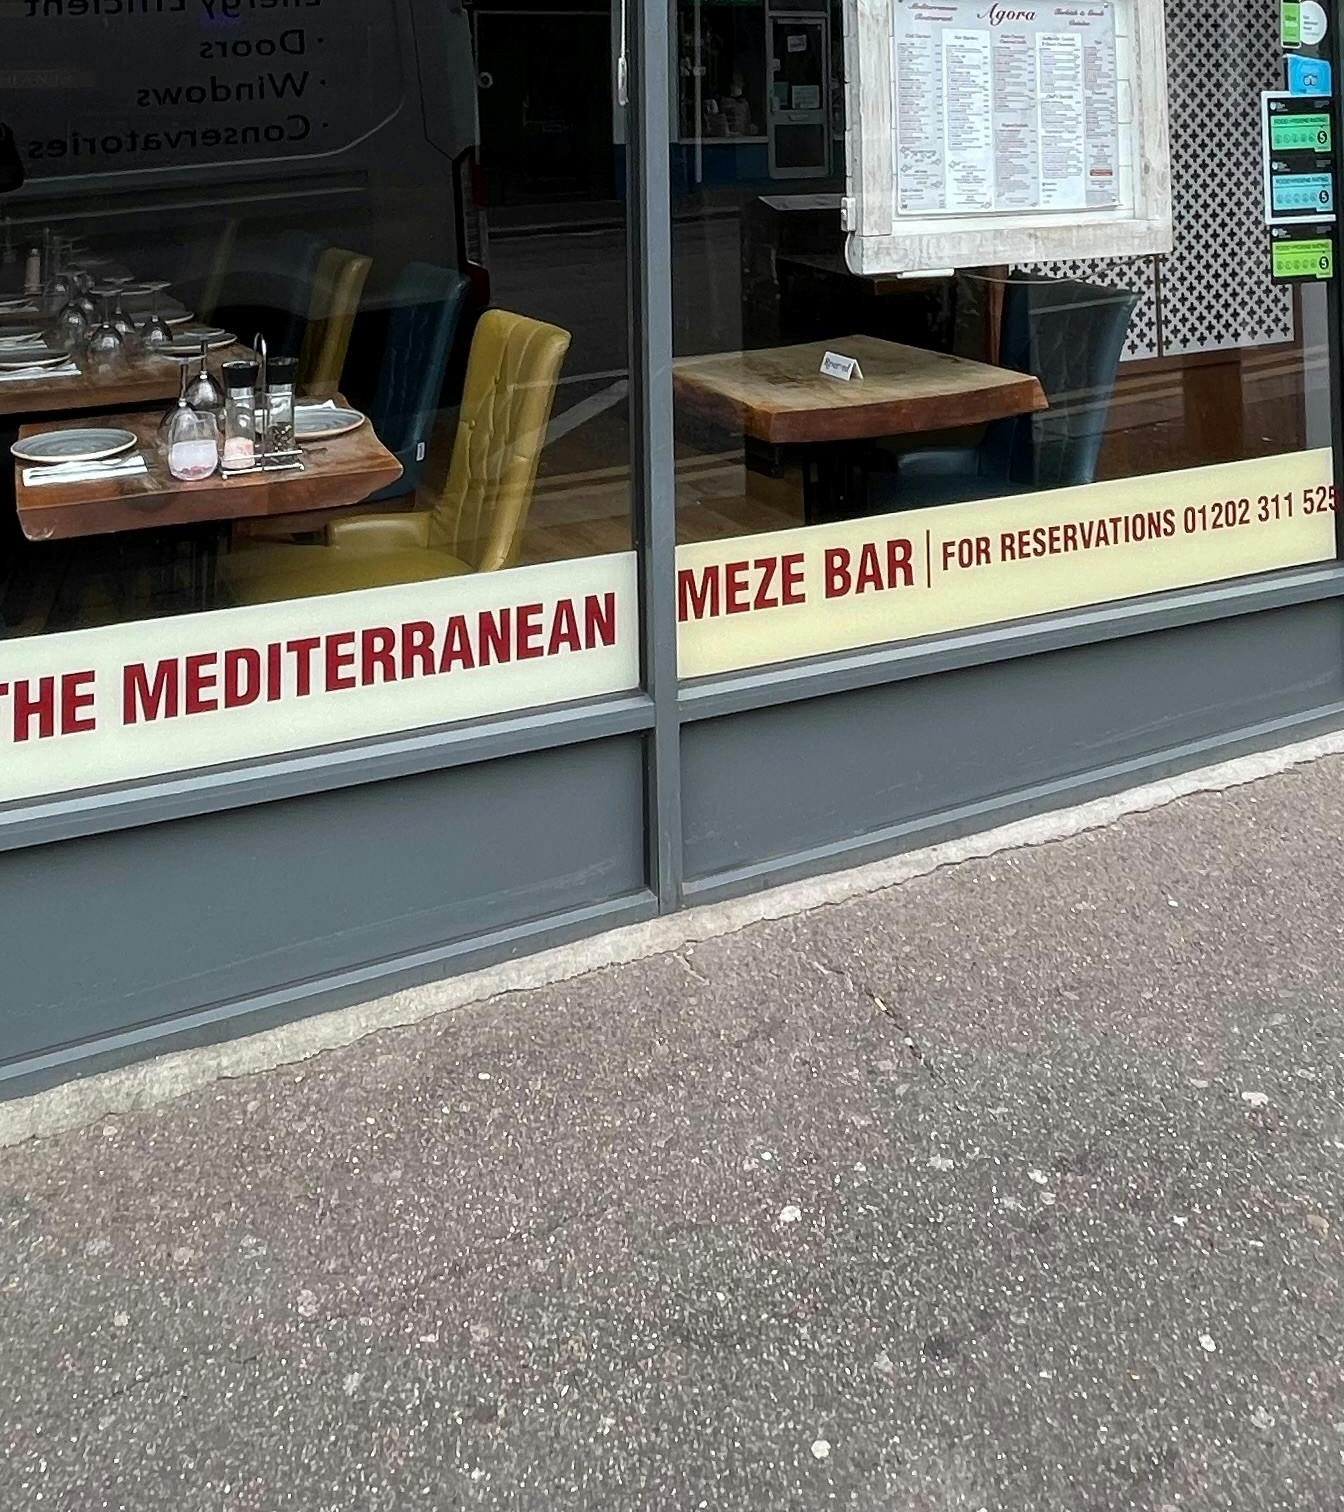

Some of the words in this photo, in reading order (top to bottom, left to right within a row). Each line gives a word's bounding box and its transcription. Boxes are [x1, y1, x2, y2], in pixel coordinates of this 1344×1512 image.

[977, 2, 1037, 26] Agora
[678, 553, 806, 622] MEZE
[824, 539, 914, 598] BAR
[941, 536, 992, 571] FOR
[1001, 509, 1176, 560] RESERVATIONS
[1184, 498, 1250, 533] 01202
[1258, 492, 1293, 522] 311
[1303, 485, 1338, 514] 525
[123, 592, 618, 725] MEDITERRANEAN
